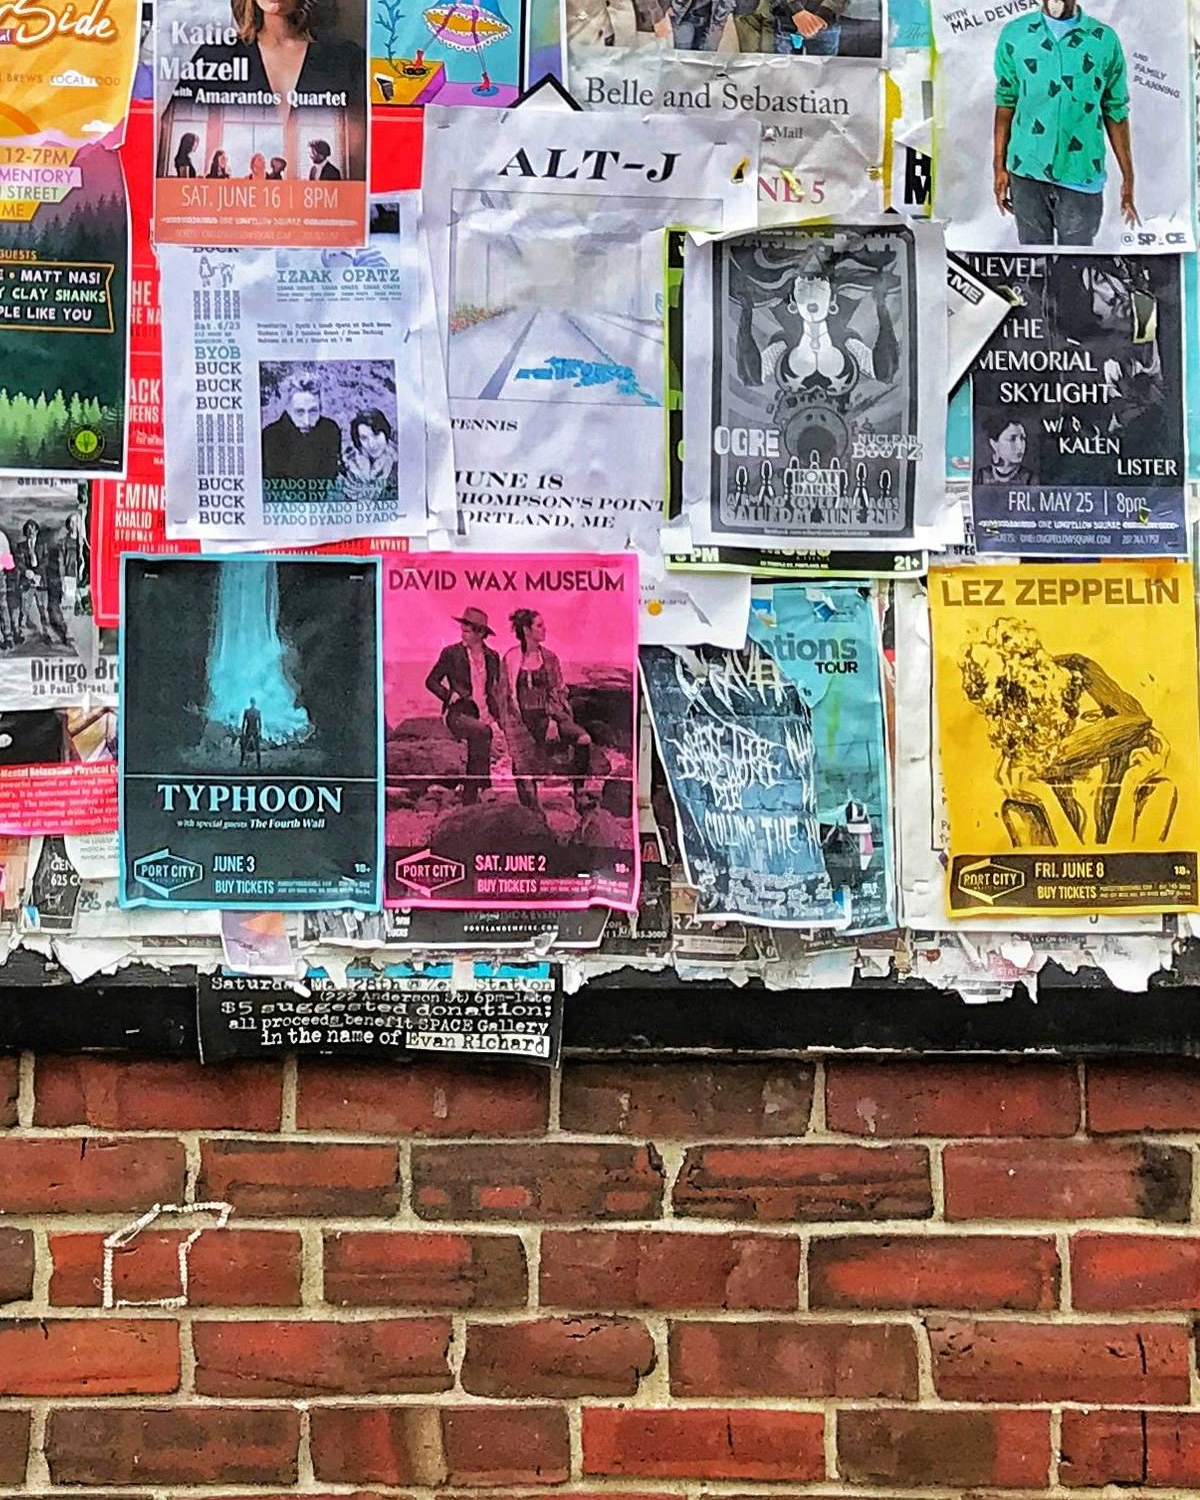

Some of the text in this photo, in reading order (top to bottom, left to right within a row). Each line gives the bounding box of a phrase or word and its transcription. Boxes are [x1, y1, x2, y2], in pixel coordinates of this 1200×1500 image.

[951, 15, 982, 34] MAL
[585, 75, 849, 117] Belle and Sebastian
[7, 147, 69, 163] 12-7PM
[497, 146, 682, 184] ALT-J
[7, 185, 59, 200] STREET
[2, 202, 24, 217] ME
[277, 269, 400, 283] IZAAK OPATZ
[975, 257, 1044, 278] LEVEL
[195, 346, 241, 359] BYOB
[979, 350, 1098, 372] MEMORIAL
[1000, 383, 1113, 404] SKYLIGHT
[1060, 436, 1120, 454] KALEN
[1117, 459, 1178, 476] LISTER
[199, 496, 245, 508] BUCK
[199, 512, 245, 525] BUCK
[389, 569, 624, 591] DAVID WAX MUSEUM
[941, 578, 1180, 607] LEZ ZEPPELIN
[31, 658, 87, 684] Dirigo
[815, 661, 859, 674] TOUR
[158, 784, 344, 813] TYPHOON
[250, 818, 267, 829] The
[268, 818, 300, 829] Fourth
[301, 818, 325, 829] Wall
[403, 864, 458, 878] PORT CITY
[215, 880, 235, 894] BUY
[237, 880, 275, 894] TICKETS
[221, 1001, 552, 1018] $5 suggested donation;
[229, 1016, 549, 1035] all proceeds benefit SPACE Gallery
[261, 1029, 546, 1055] in the name of Evan Richard
